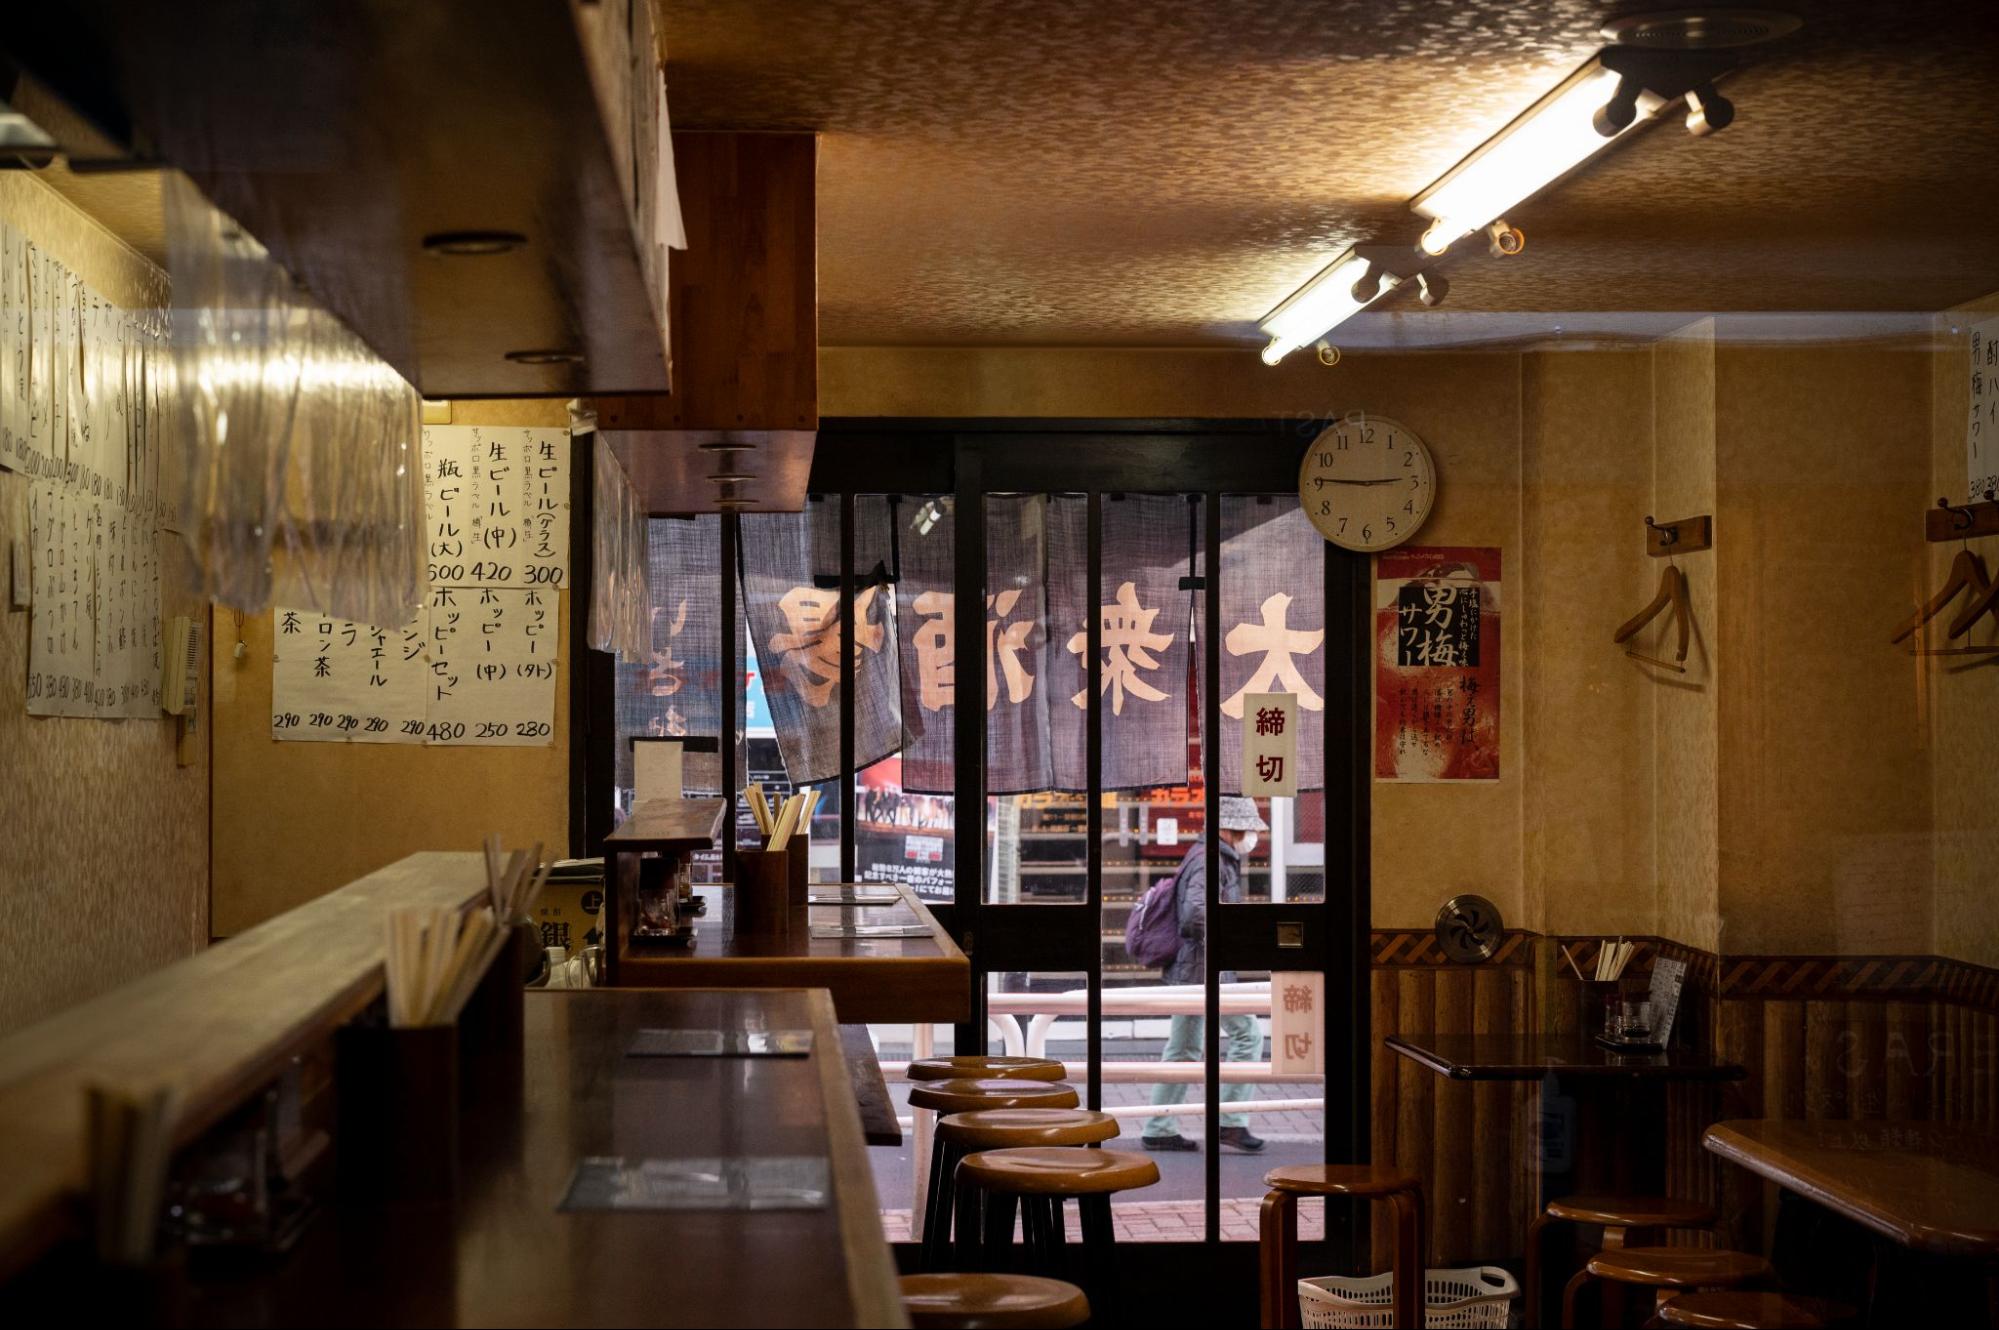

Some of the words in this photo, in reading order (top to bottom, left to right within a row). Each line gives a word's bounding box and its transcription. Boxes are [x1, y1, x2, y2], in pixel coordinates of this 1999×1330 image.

[1337, 435, 1349, 450] 11
[1360, 428, 1375, 444] 12
[1387, 434, 1394, 450] 1
[1319, 451, 1334, 468] 10
[1403, 451, 1414, 467] 2
[1314, 477, 1324, 492] 9
[1409, 475, 1419, 491] 3
[1321, 500, 1331, 516] 8
[1402, 499, 1413, 515] 4
[1338, 517, 1348, 533] 7
[1362, 524, 1372, 540] 6
[1386, 516, 1396, 533] 5
[471, 562, 512, 582] 420
[523, 565, 563, 584] 300
[1416, 584, 1459, 667] 男梅
[403, 619, 426, 661] ンジ
[1399, 602, 1423, 667] サワー
[431, 588, 461, 700] ホッピーセット
[273, 712, 300, 729] 290
[309, 712, 334, 728] 290
[337, 714, 359, 731] 290
[364, 716, 389, 732] 290
[400, 719, 425, 735] 290
[427, 722, 466, 741] 480
[475, 722, 508, 738] 250
[516, 721, 551, 737] 280
[1255, 707, 1286, 783] 締切
